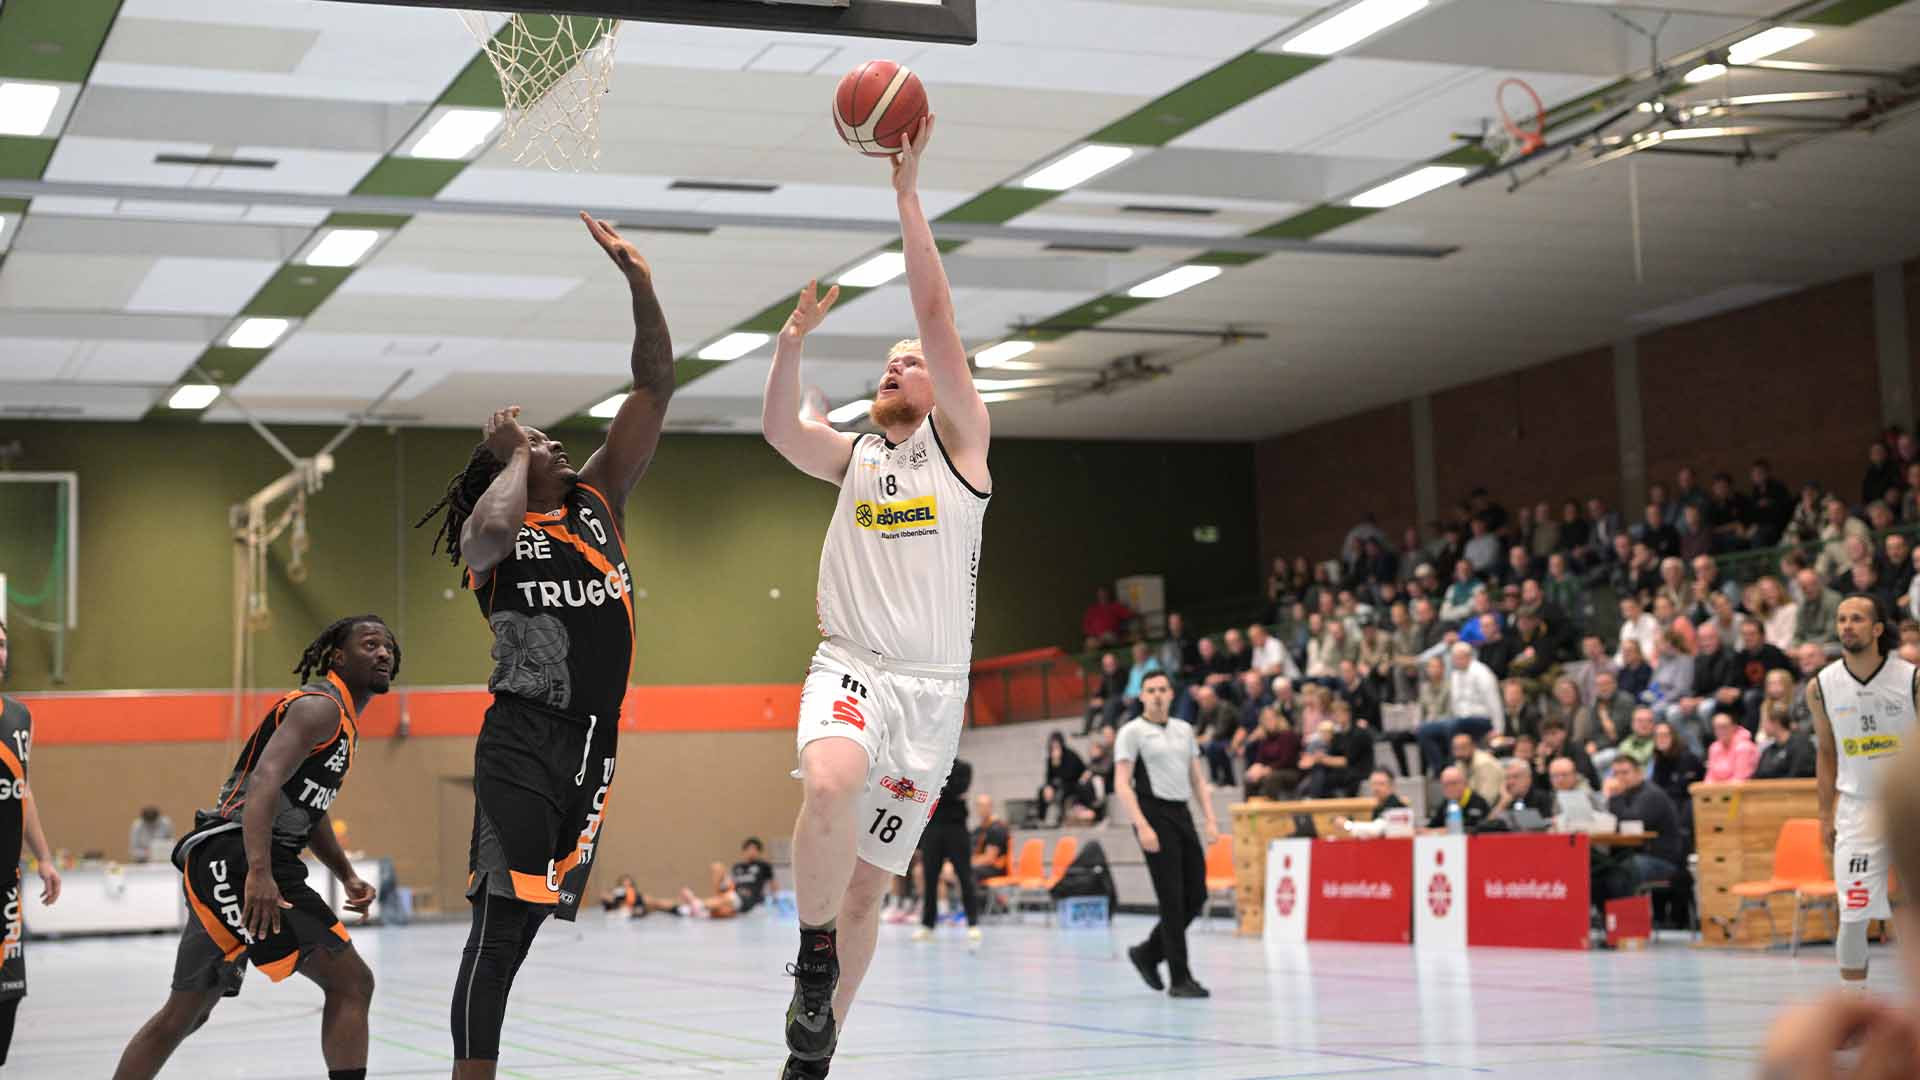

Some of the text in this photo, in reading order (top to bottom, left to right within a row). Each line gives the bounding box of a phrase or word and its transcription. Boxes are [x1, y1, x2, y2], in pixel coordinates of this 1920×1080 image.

[579, 507, 607, 545] 6
[876, 507, 934, 525] BÖRGEL
[515, 540, 552, 560] RE
[516, 561, 632, 608] TRUGGE
[1861, 715, 1877, 732] 35
[576, 757, 615, 865] PURE
[869, 807, 903, 844] 18
